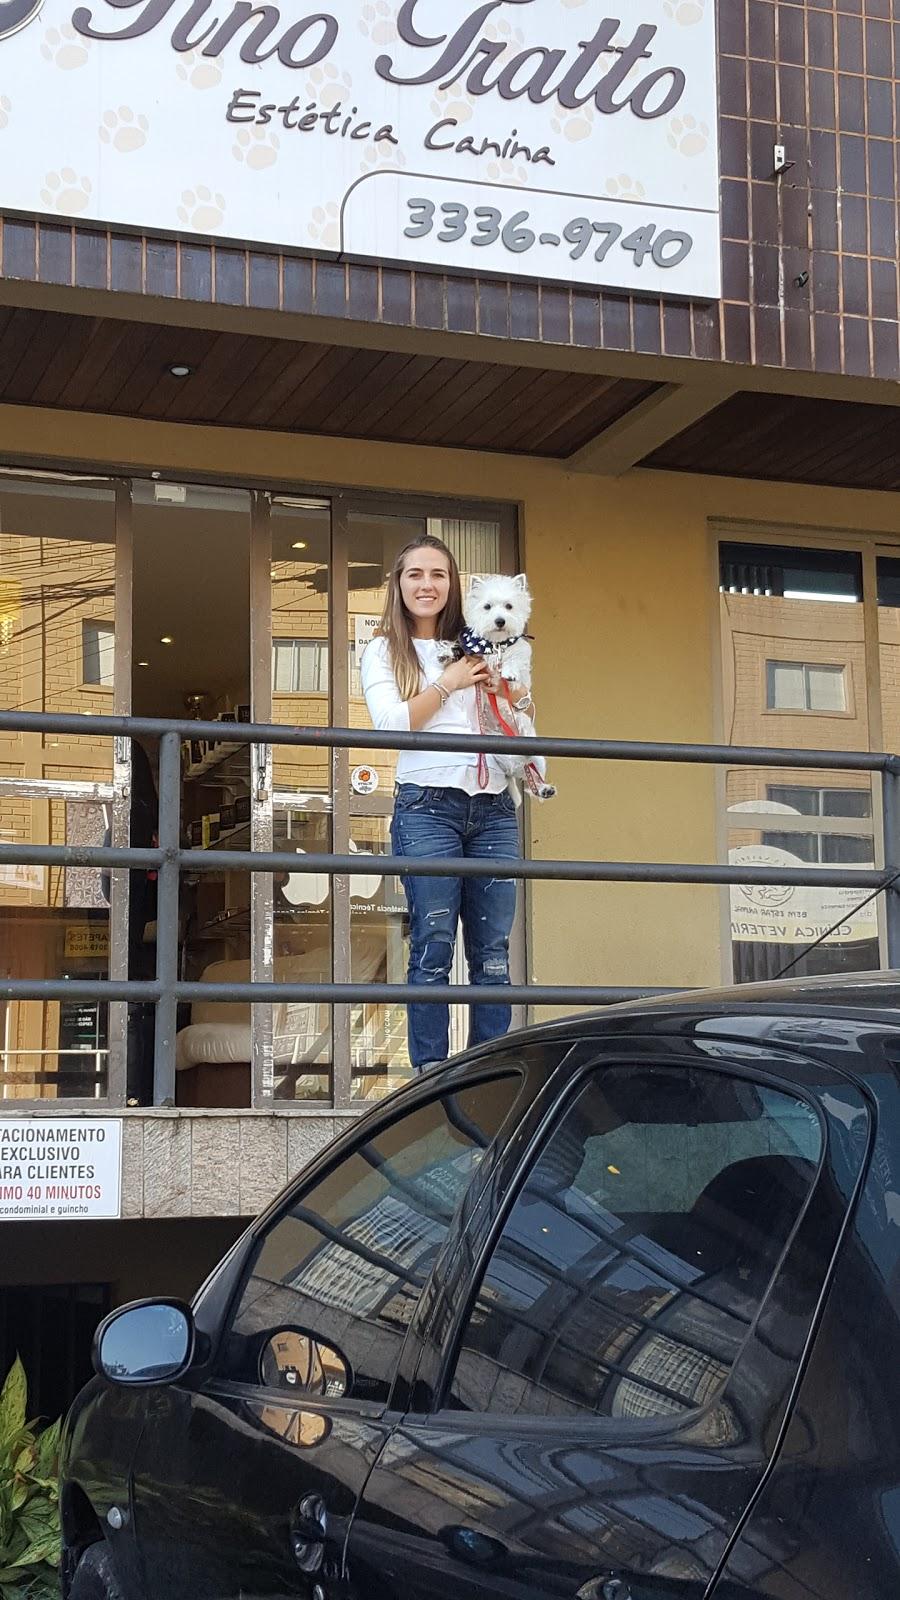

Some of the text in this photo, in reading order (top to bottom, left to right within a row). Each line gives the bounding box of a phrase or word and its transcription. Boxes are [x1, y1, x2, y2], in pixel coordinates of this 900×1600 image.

[375, 0, 686, 119] Tratto
[226, 88, 556, 165] Estética Canina
[404, 198, 693, 267] 3336-9740
[0, 1128, 105, 1142] ACIONAMENTO
[1, 1146, 80, 1160] EXCLUSIVO
[0, 1165, 95, 1179] RA CLIENTES
[27, 1186, 41, 1199] 40
[45, 1185, 101, 1199] MINUTOS
[57, 1204, 89, 1215] guincho
